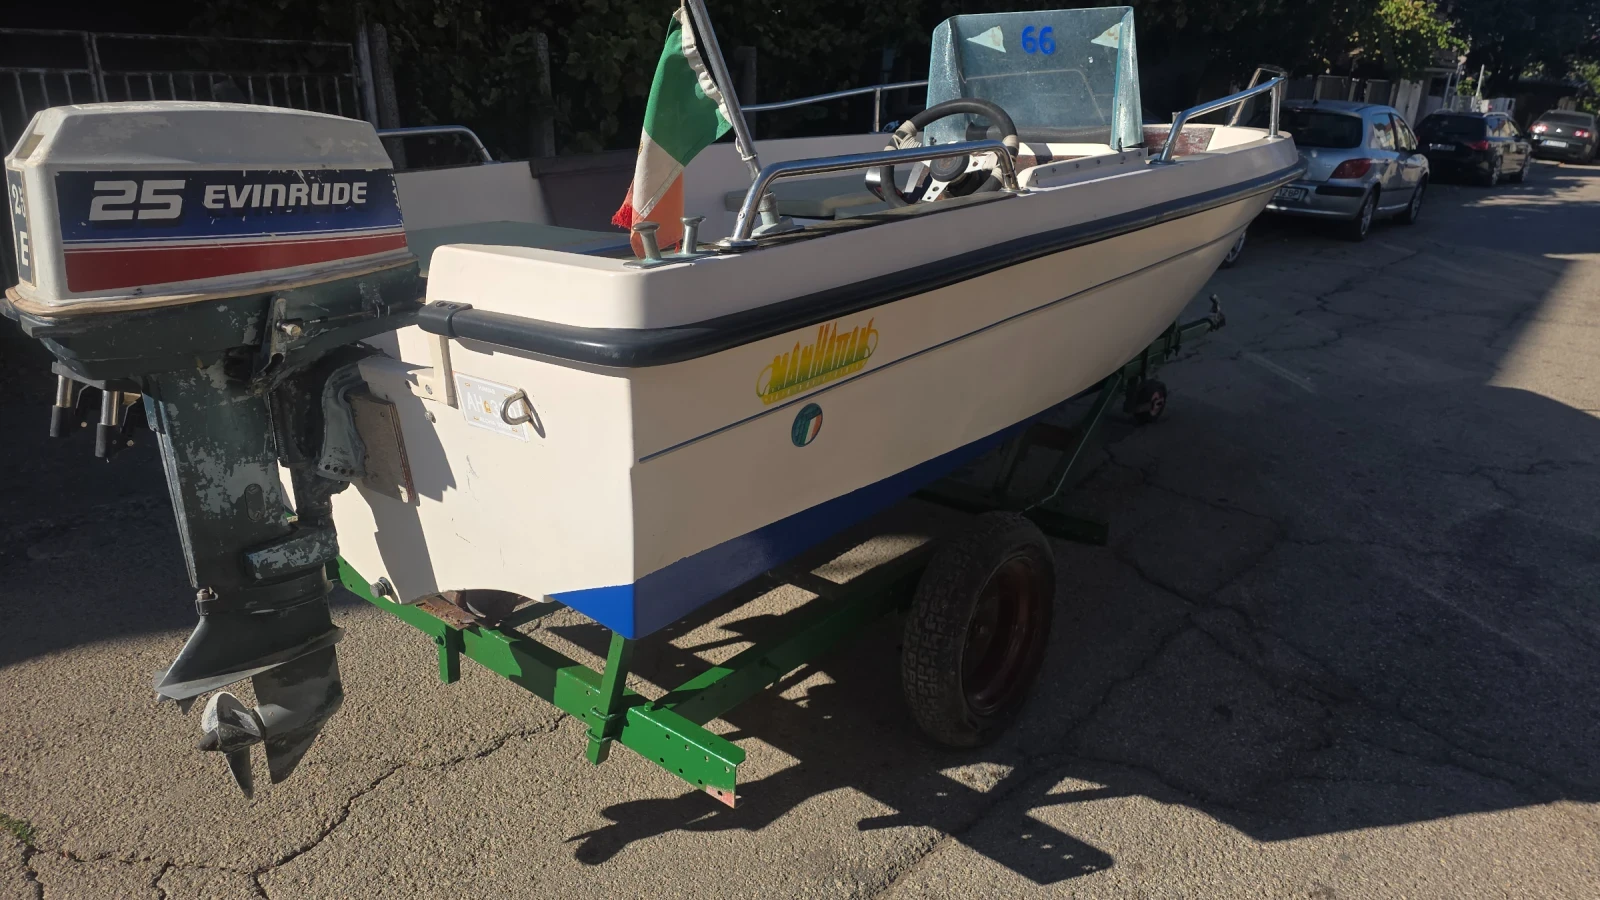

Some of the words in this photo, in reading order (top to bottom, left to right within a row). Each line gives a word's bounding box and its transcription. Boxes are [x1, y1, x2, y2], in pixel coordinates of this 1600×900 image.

[1021, 25, 1056, 55] 66
[89, 179, 186, 221] 25
[203, 182, 368, 209] EVINRUDE
